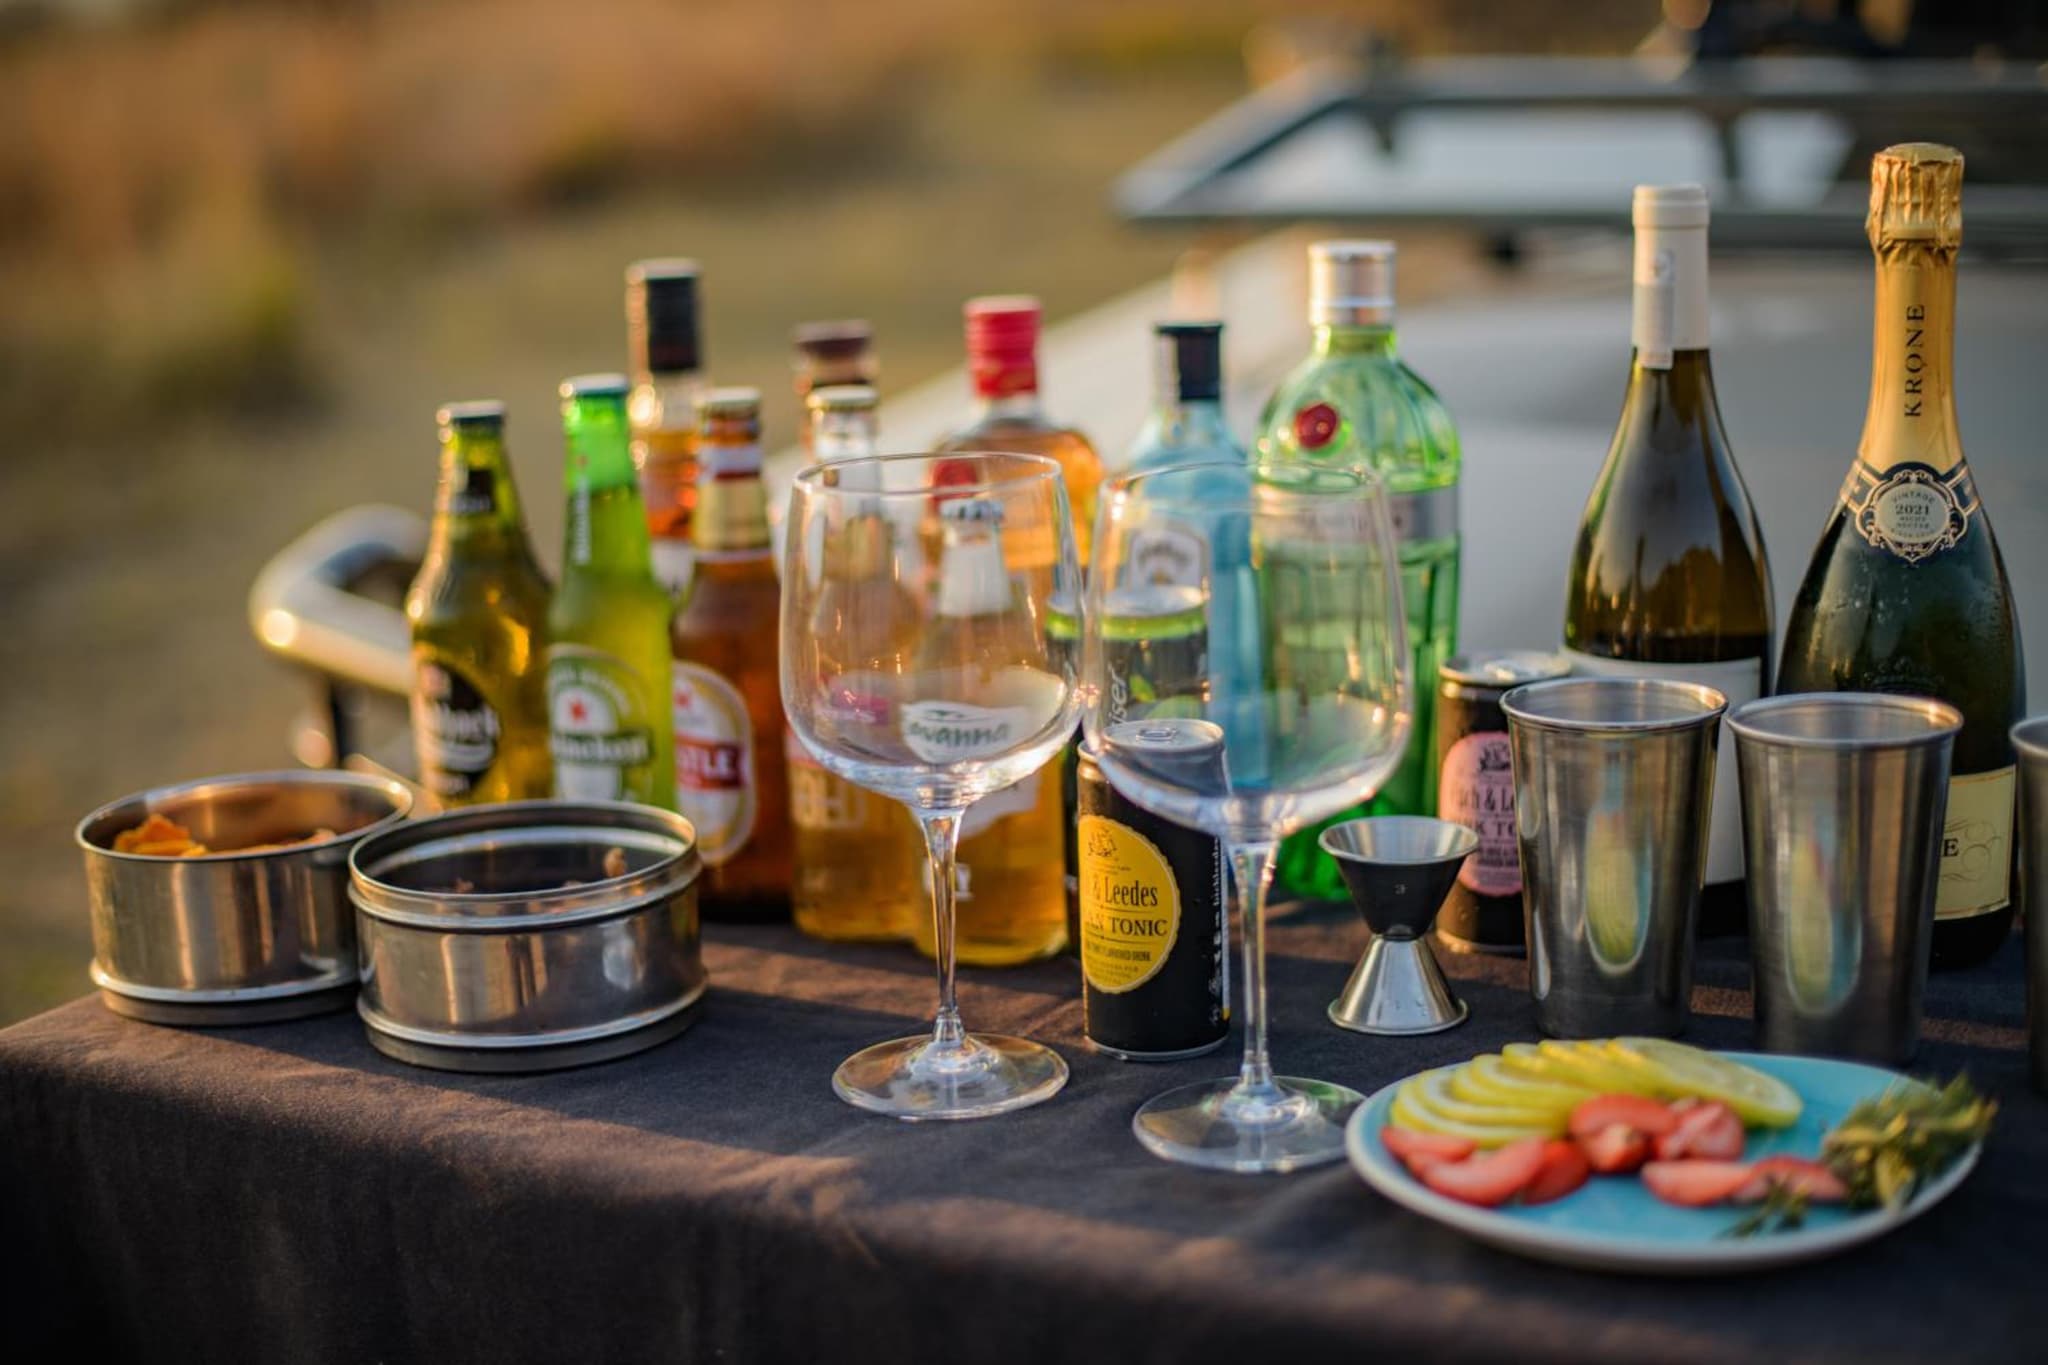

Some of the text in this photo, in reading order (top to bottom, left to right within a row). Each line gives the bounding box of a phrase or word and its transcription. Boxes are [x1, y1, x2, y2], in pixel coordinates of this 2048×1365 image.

[1904, 304, 1925, 417] KRONE
[1895, 504, 1930, 515] 2021
[1104, 876, 1158, 907] Leedes
[1108, 916, 1168, 937] TONIC
